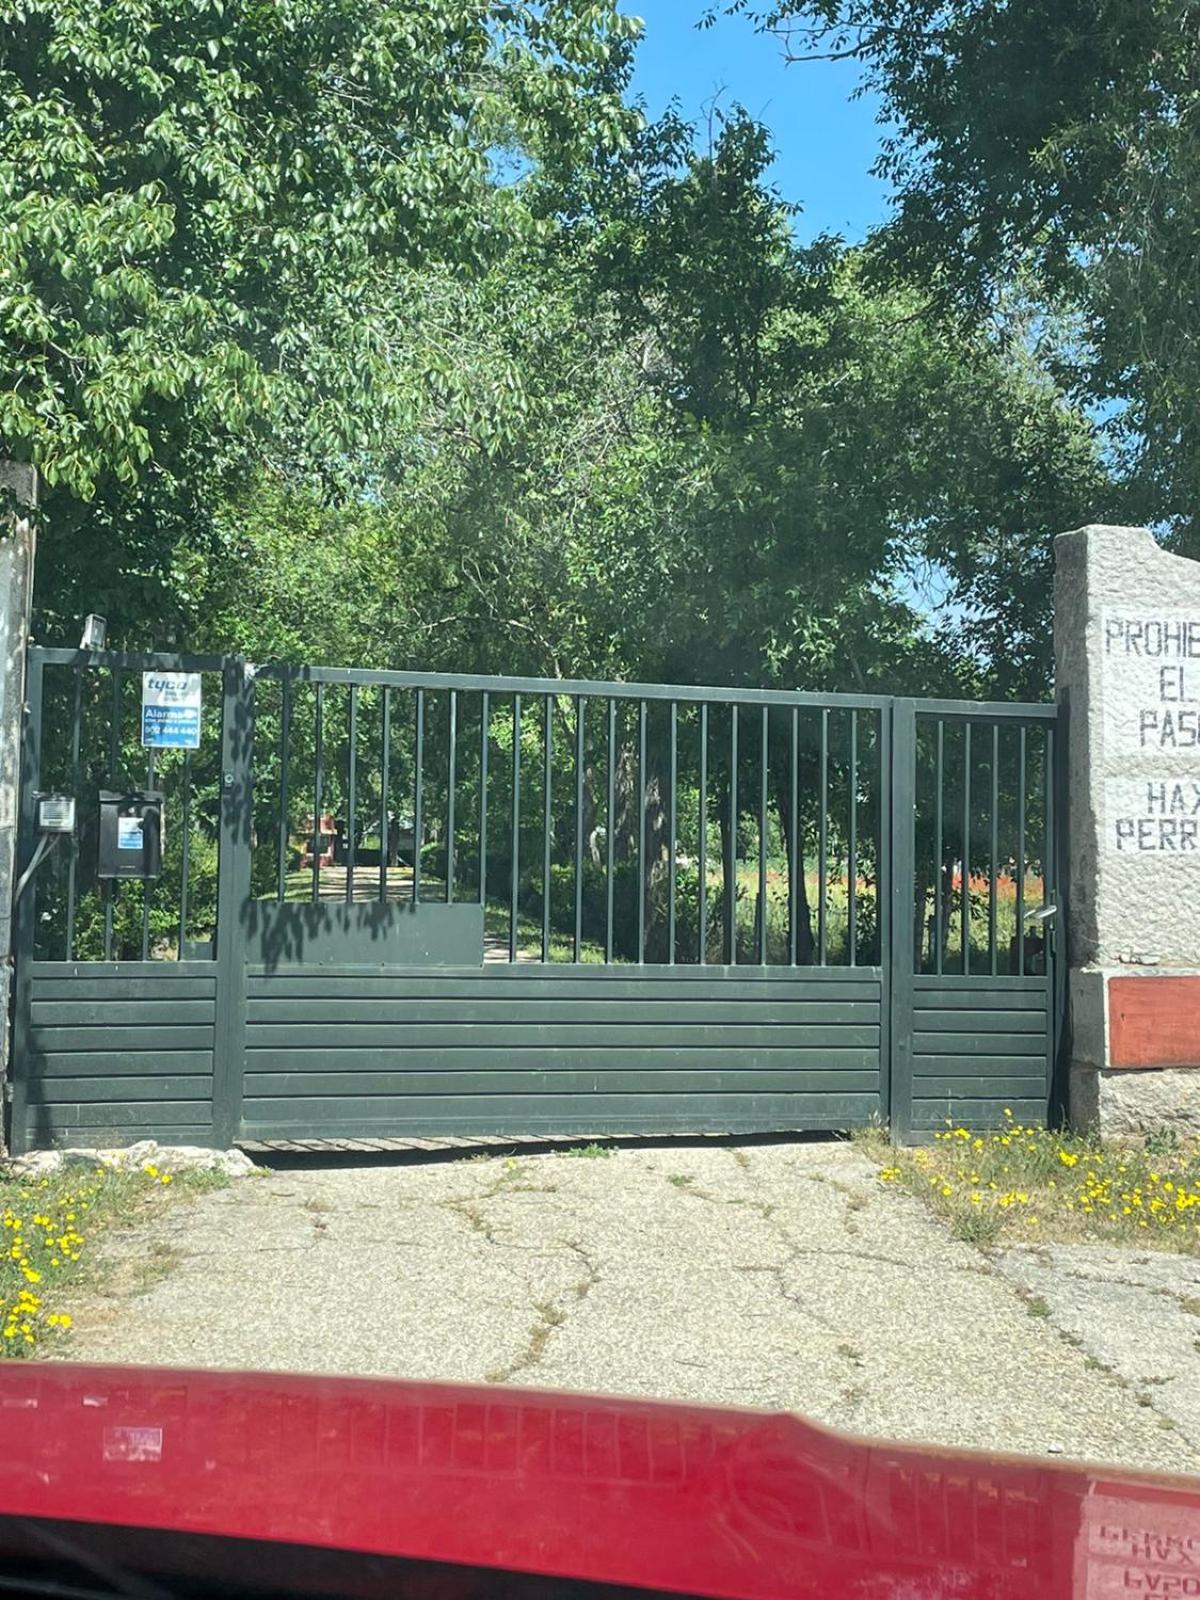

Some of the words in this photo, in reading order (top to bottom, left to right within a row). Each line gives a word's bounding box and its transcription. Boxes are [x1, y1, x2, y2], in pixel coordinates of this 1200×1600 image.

[147, 678, 187, 692] tyco
[1160, 665, 1197, 702] EL
[1140, 709, 1200, 747] PAS
